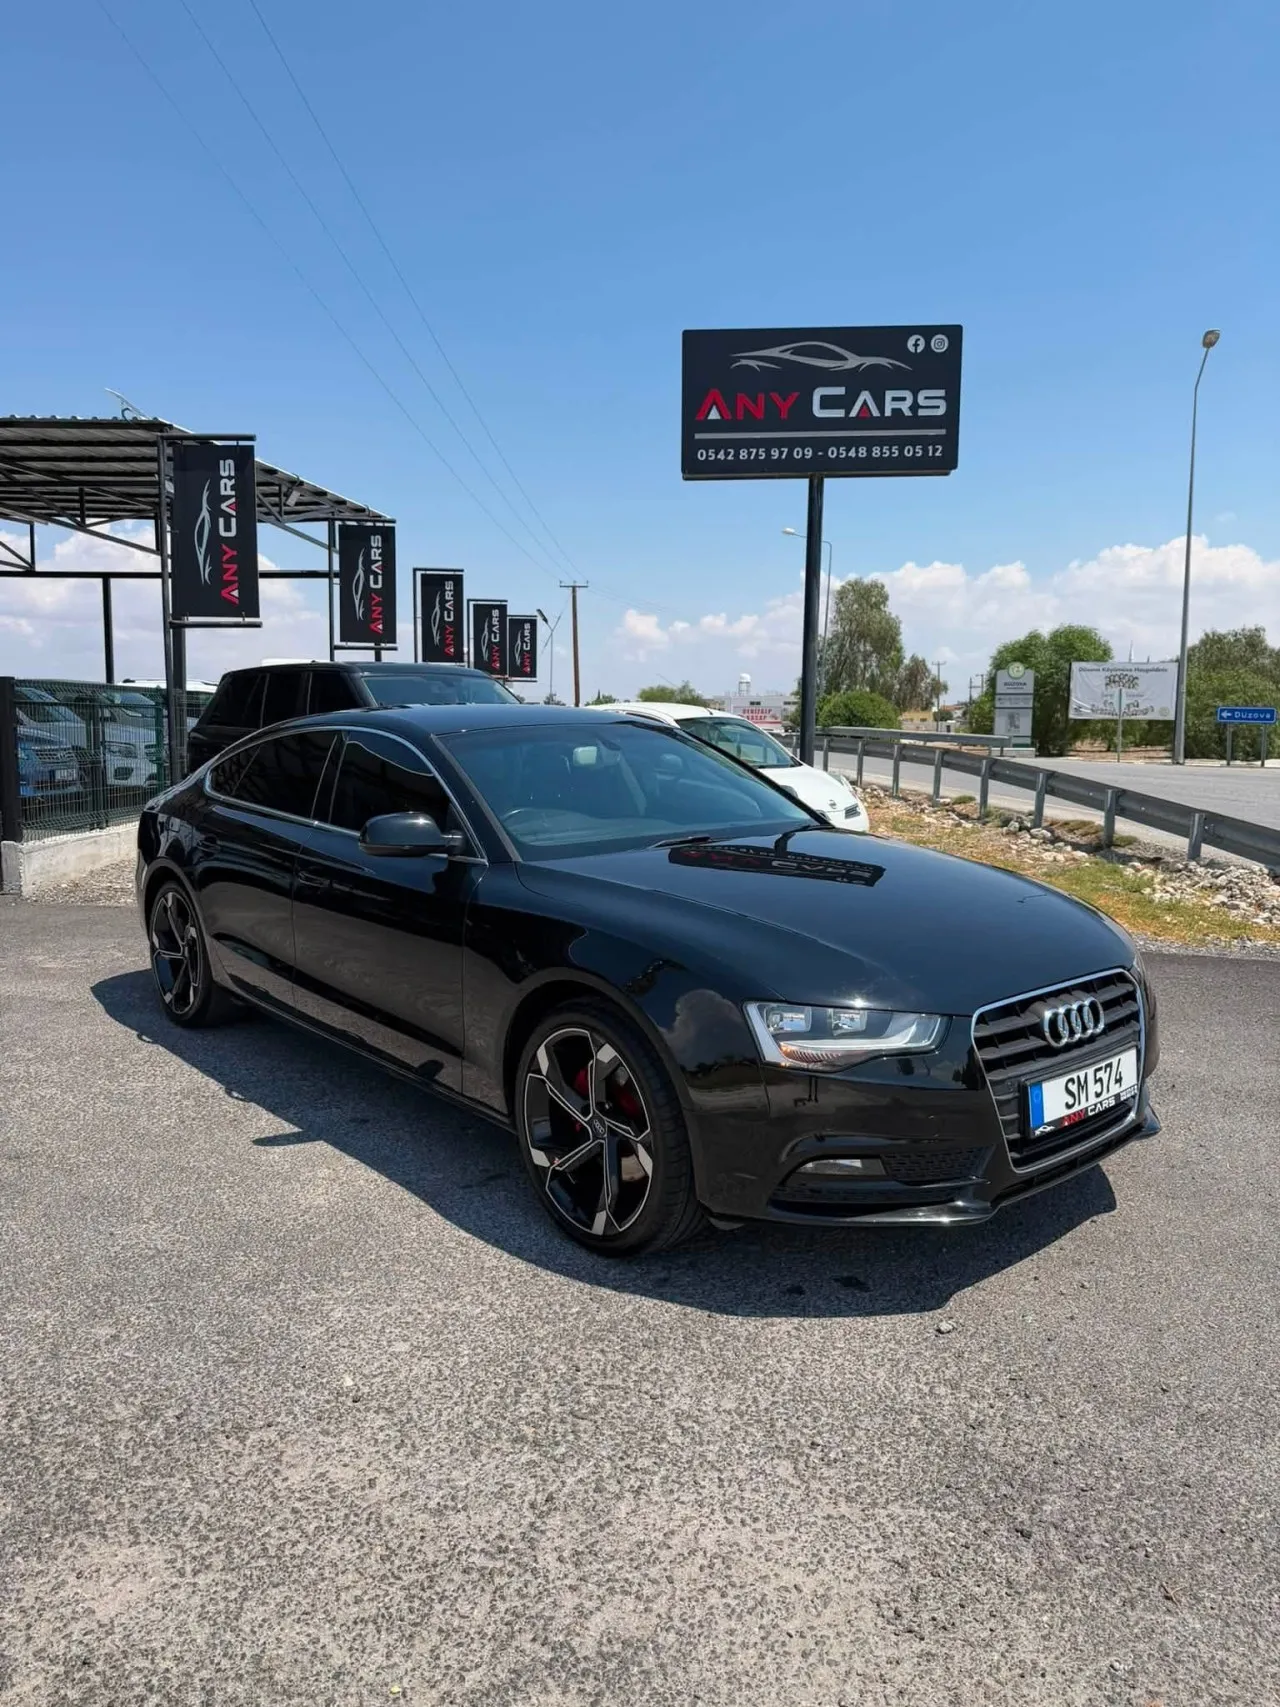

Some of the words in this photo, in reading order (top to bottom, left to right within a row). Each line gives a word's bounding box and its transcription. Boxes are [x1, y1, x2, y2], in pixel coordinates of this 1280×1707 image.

[695, 388, 800, 420] ANY
[812, 386, 947, 418] CARS
[697, 449, 734, 461] 0542
[739, 448, 766, 460] 875
[770, 447, 789, 459] 97
[793, 447, 813, 459] 09
[828, 447, 867, 459] 0548
[872, 446, 899, 457] 855
[904, 445, 923, 457] 05
[927, 445, 943, 456] 12
[219, 458, 238, 538] CARS
[220, 544, 239, 605] ANY
[370, 535, 383, 589] CARS
[369, 593, 383, 634] ANY
[444, 580, 454, 622] CARS
[444, 625, 455, 656] ANY
[491, 609, 500, 642] CARS
[491, 645, 500, 670] ANY
[522, 652, 531, 674] ANY
[1064, 1072, 1089, 1110] SM
[1094, 1058, 1123, 1098] 574
[1060, 1109, 1086, 1127] ANY
[1088, 1096, 1115, 1115] CARS
